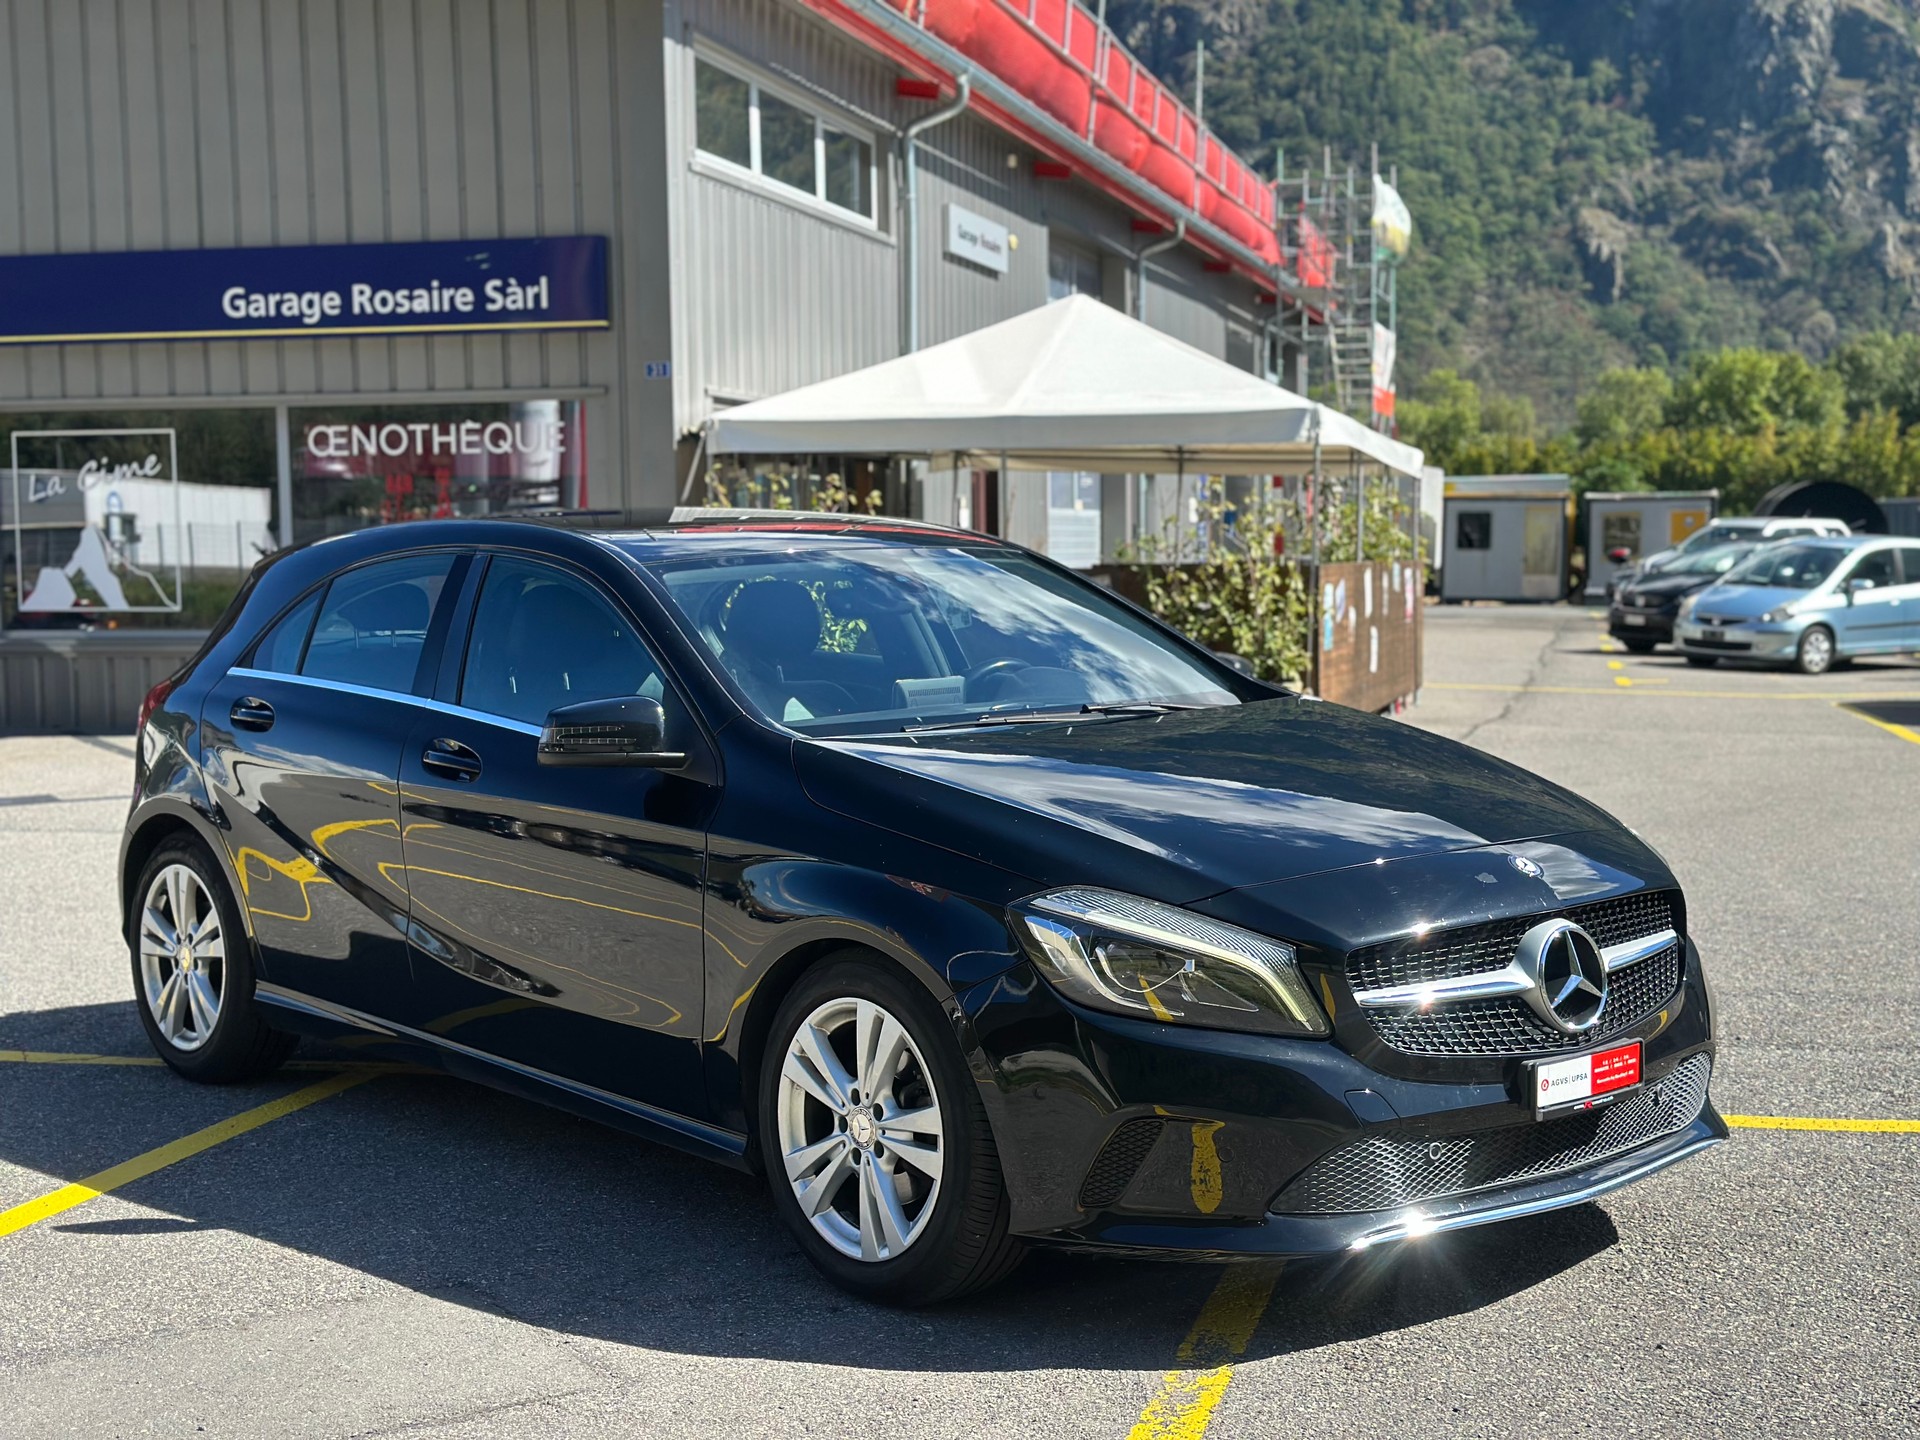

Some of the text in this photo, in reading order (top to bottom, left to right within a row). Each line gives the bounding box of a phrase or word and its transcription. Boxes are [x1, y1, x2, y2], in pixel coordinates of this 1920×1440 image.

[222, 275, 549, 324] Garage Rosaire Sàrl
[307, 419, 566, 457] ŒNOTHÈQUE
[28, 453, 162, 502] La Cime
[1551, 1076, 1569, 1087] AGVS
[1571, 1072, 1588, 1083] UPSA
